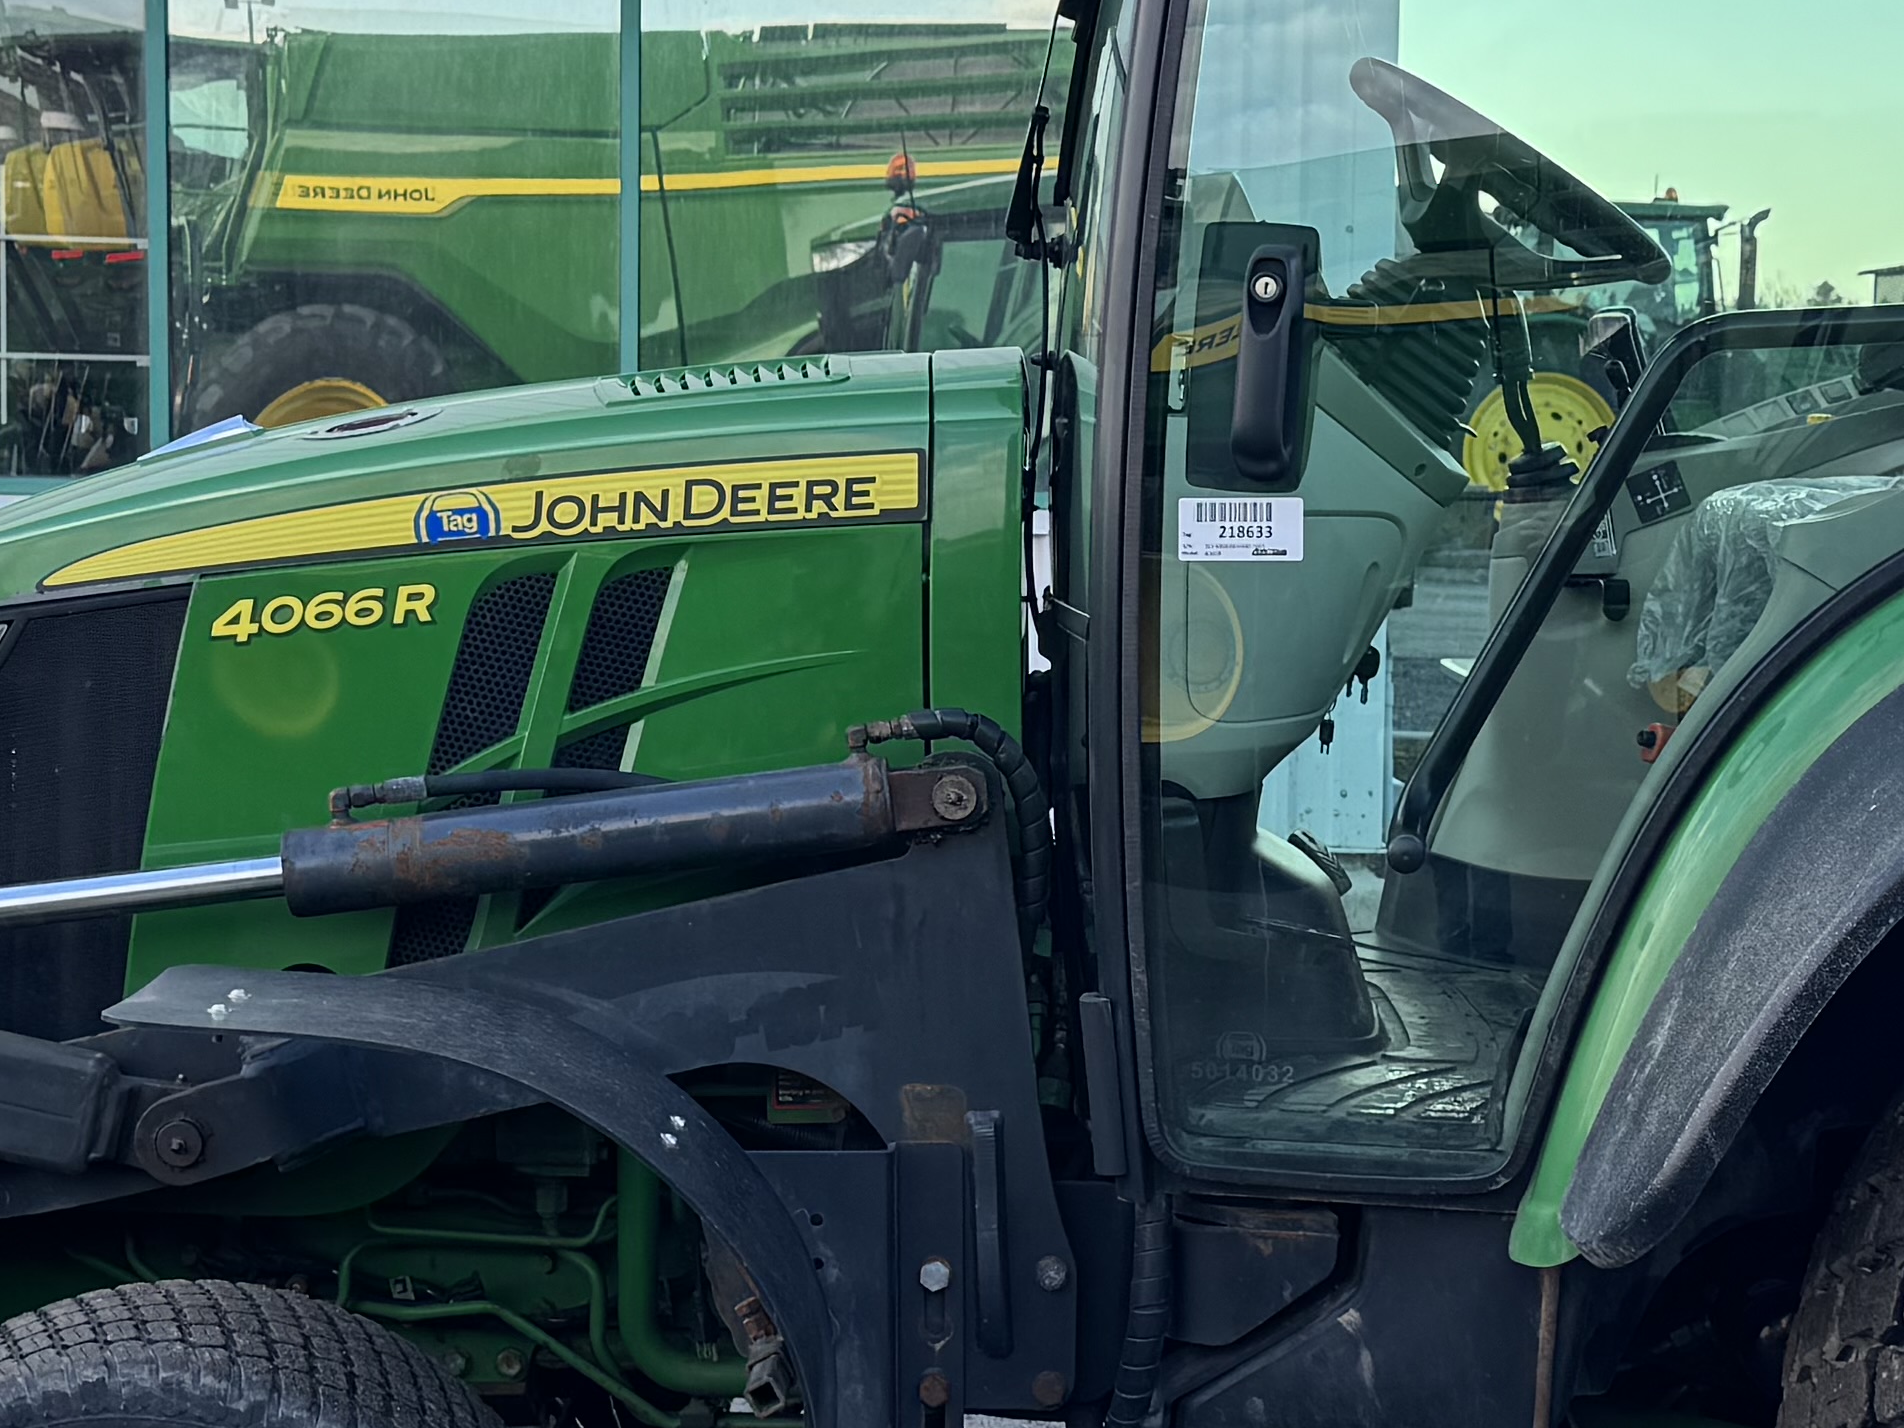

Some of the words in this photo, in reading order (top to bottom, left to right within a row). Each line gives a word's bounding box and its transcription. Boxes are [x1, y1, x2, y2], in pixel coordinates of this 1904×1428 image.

[437, 509, 478, 534] Tag
[510, 486, 672, 537] JOHN
[683, 476, 878, 524] DEERE
[1218, 524, 1273, 539] 218633
[209, 586, 386, 644] 4066
[392, 582, 437, 627] R
